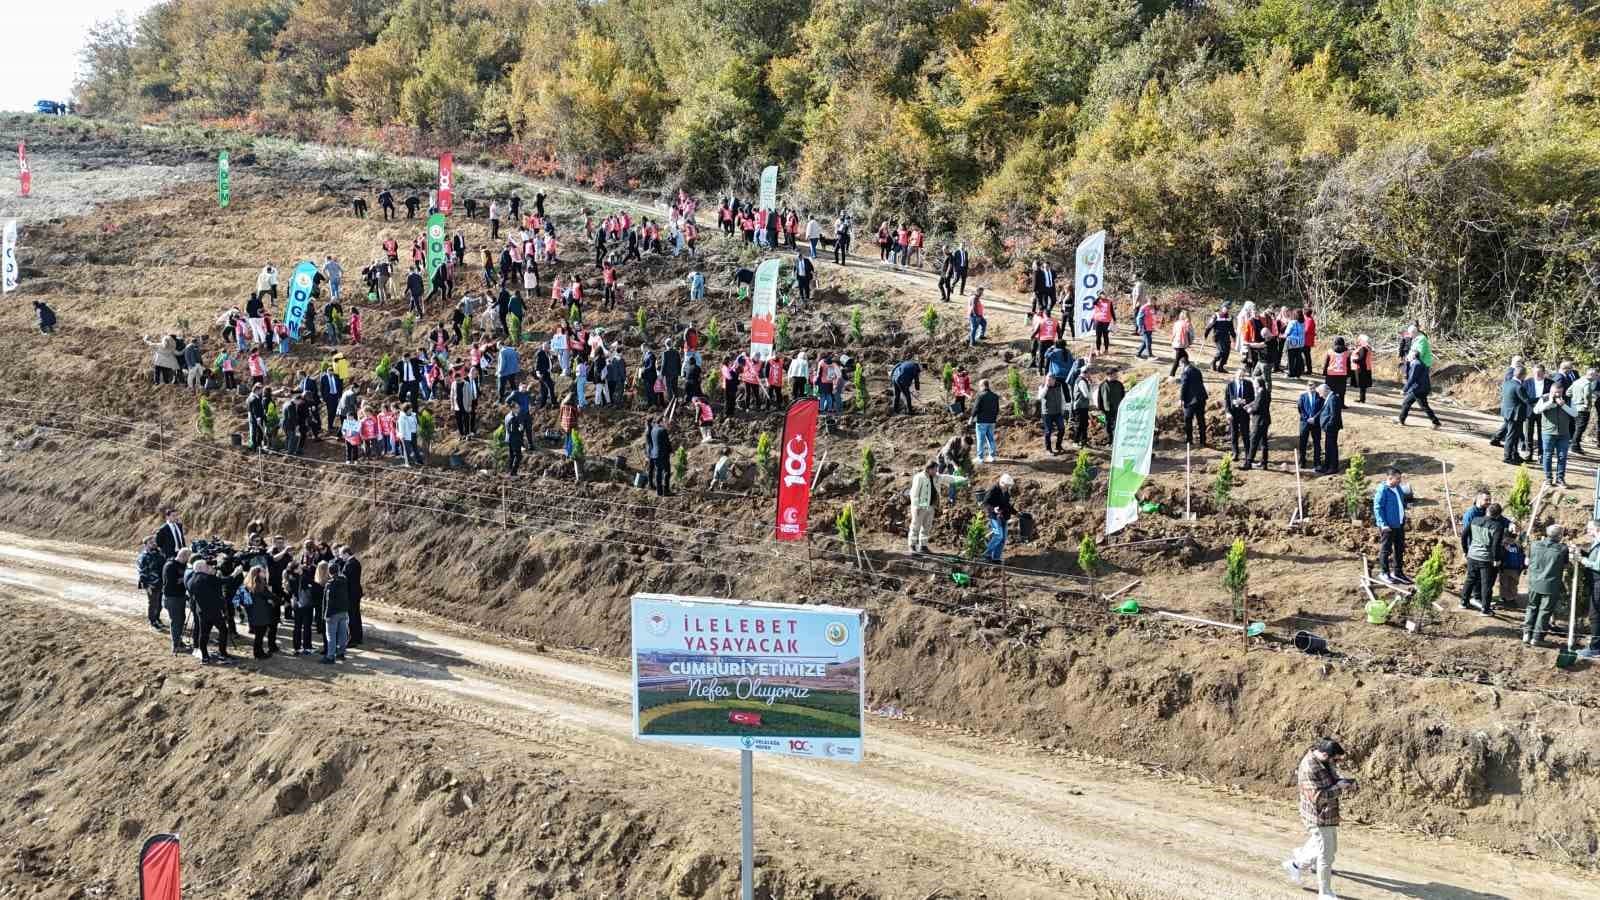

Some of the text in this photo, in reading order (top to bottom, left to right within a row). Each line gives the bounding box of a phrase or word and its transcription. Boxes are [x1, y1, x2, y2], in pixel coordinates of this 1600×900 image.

[288, 289, 307, 332] OGM
[684, 614, 798, 635] İLELEBET
[684, 636, 800, 656] YAŞAYACAK
[668, 658, 827, 677] CUMHURİYETİMİZE
[688, 676, 811, 705] Nefes Oluyoruz
